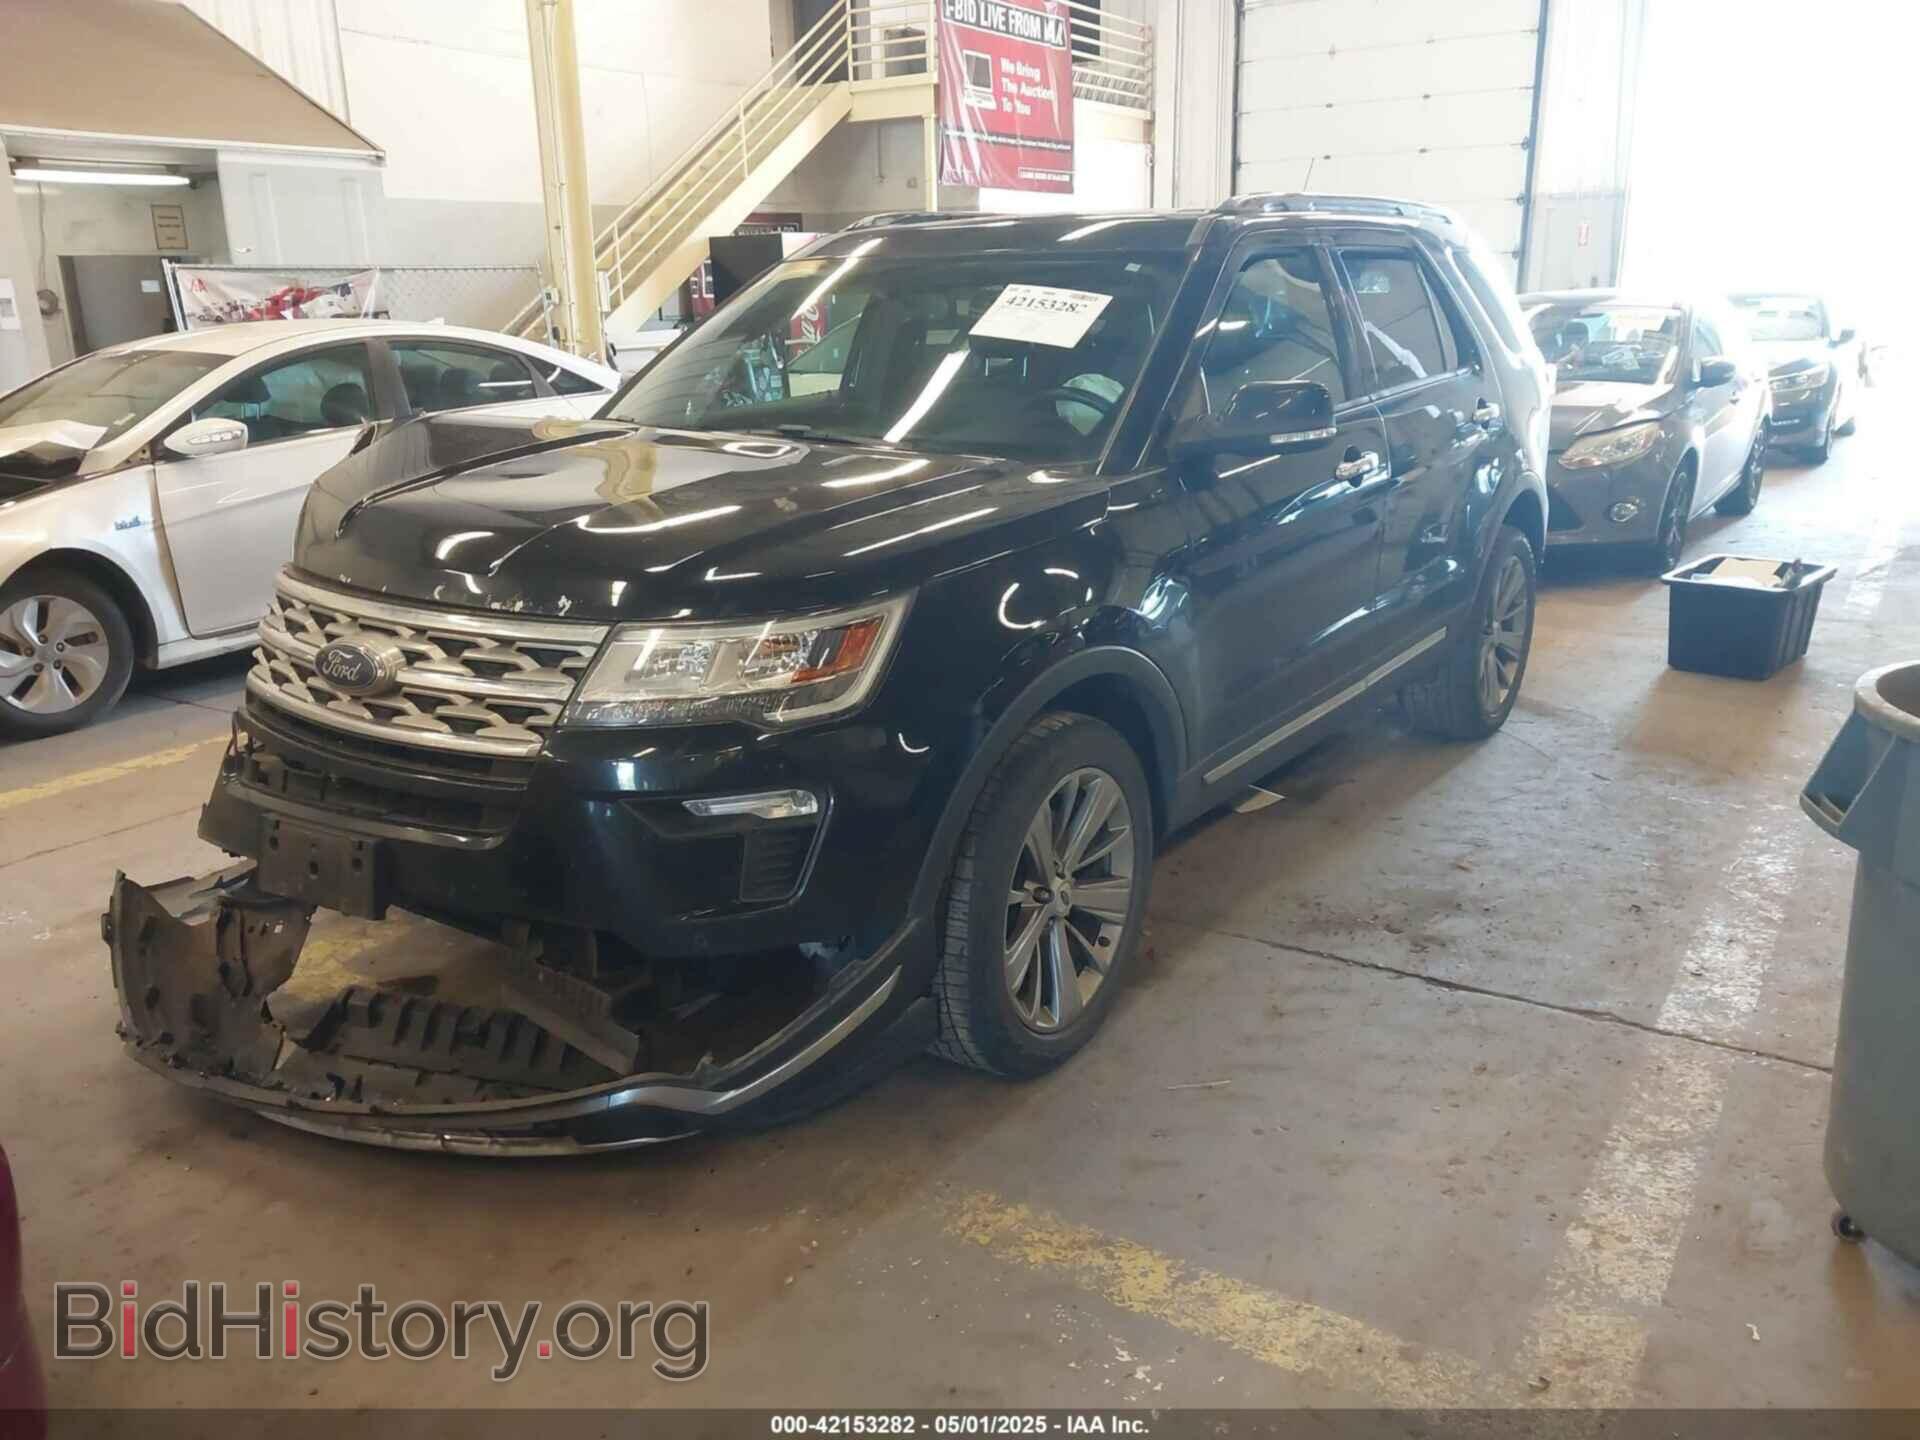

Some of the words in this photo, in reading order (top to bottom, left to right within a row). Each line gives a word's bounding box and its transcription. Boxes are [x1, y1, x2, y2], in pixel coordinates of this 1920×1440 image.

[980, 2, 1006, 31] LIVE
[1009, 9, 1041, 39] FROM
[1000, 57, 1015, 74] We
[1016, 61, 1040, 82] Bring
[1001, 77, 1018, 94] The
[1020, 82, 1056, 101] Auction
[1002, 97, 1013, 112] To
[1014, 99, 1031, 116] You
[322, 649, 361, 681] Ford
